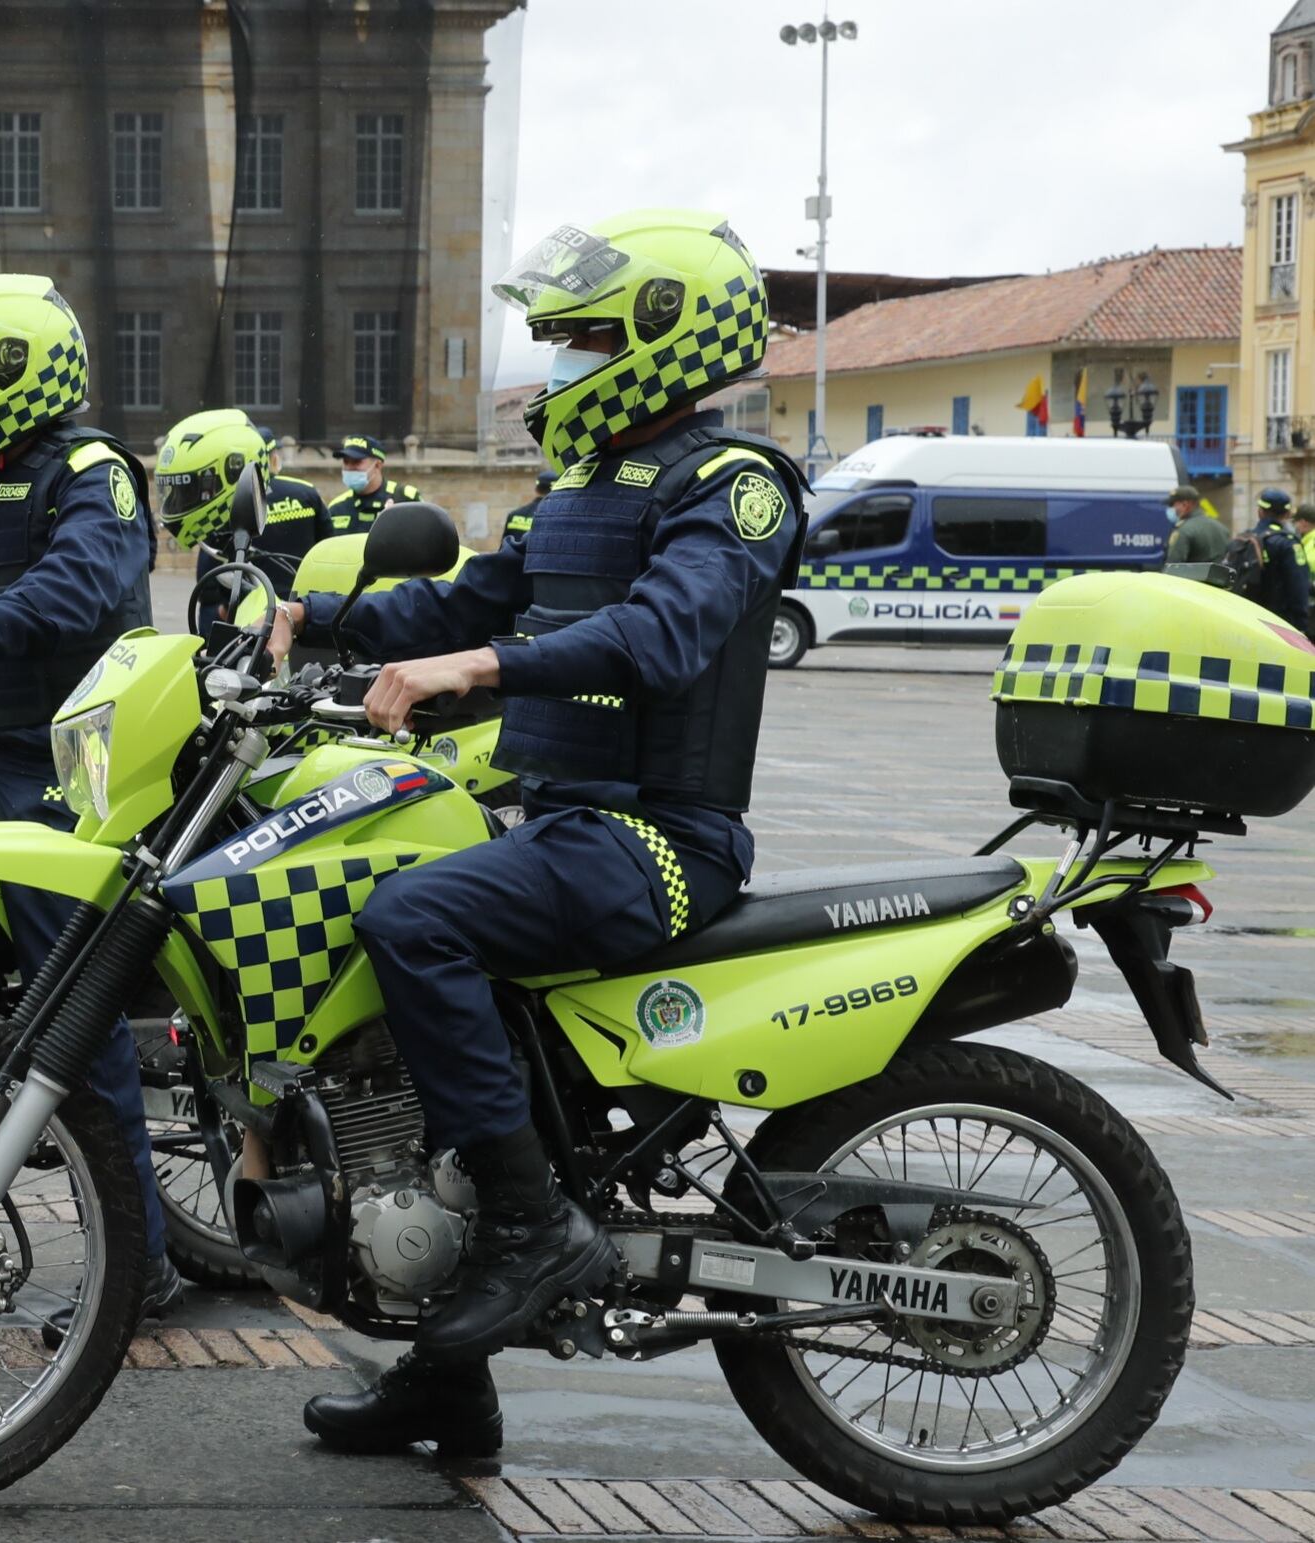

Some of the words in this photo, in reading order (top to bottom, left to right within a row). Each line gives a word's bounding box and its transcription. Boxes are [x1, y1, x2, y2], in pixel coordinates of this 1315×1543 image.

[266, 496, 303, 515] LICÍA
[873, 597, 993, 620] POLICÍA
[223, 787, 360, 865] POLICÍA
[824, 892, 931, 929] YAMAHA
[770, 974, 919, 1031] 17-9969
[830, 1266, 949, 1314] YAMAHA
